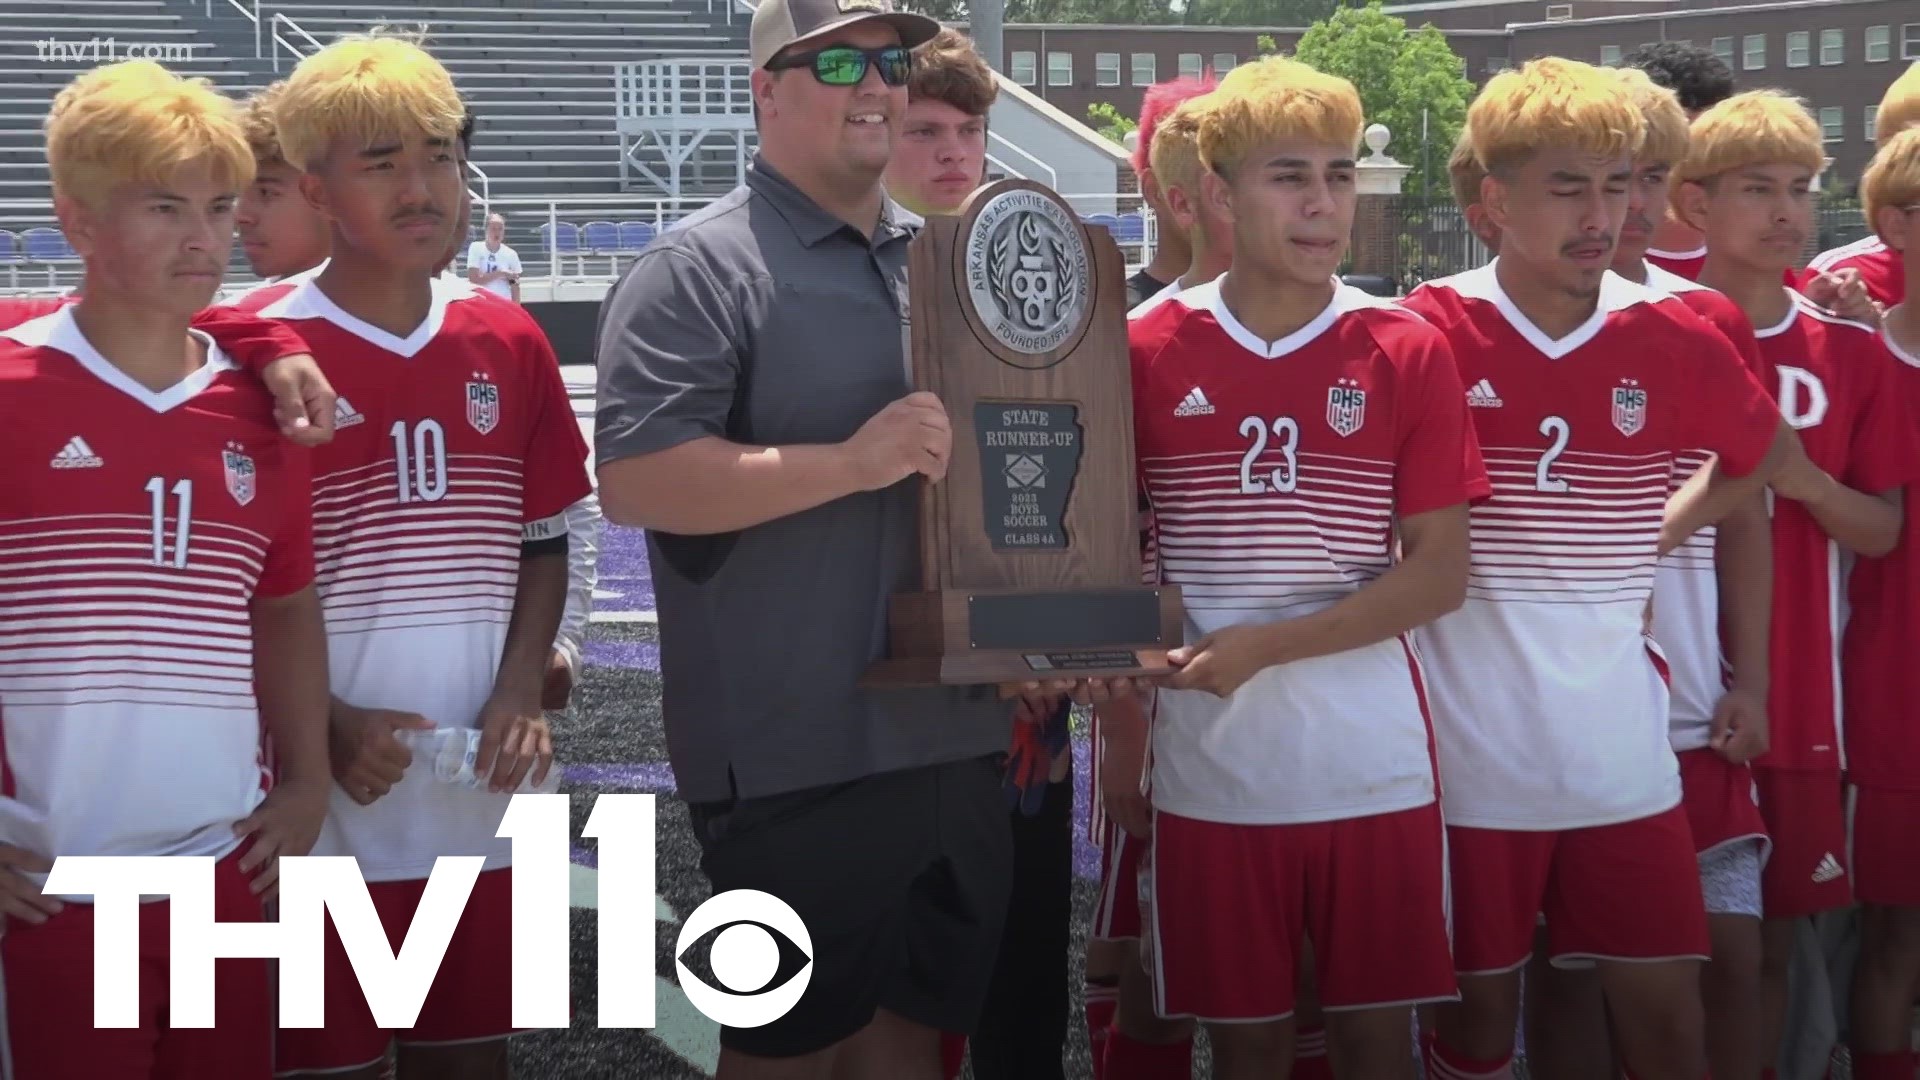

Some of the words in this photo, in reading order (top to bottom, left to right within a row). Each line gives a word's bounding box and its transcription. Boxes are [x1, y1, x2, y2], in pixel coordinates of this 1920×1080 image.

[970, 214, 994, 291] ARKANSAS
[992, 194, 1050, 217] ACTIVITIES
[1051, 208, 1088, 297] ASSOCIATION
[995, 323, 1048, 349] FOUNDED
[470, 382, 496, 404] DHS
[1331, 387, 1365, 408] DHS
[1615, 388, 1645, 410] DHS
[1775, 363, 1829, 431] D
[1002, 409, 1049, 427] STATE
[1173, 404, 1216, 418] adidas
[986, 431, 1074, 447] RUNNER-UP
[389, 418, 448, 503] 10
[1238, 414, 1300, 495] 23
[1535, 415, 1570, 493] 2
[1011, 493, 1037, 503] 2023
[1011, 504, 1039, 515] BOYS
[144, 476, 193, 570] 11
[1003, 515, 1048, 527] SOCCER
[1005, 534, 1040, 545] CLASS
[1041, 533, 1056, 544] 4A
